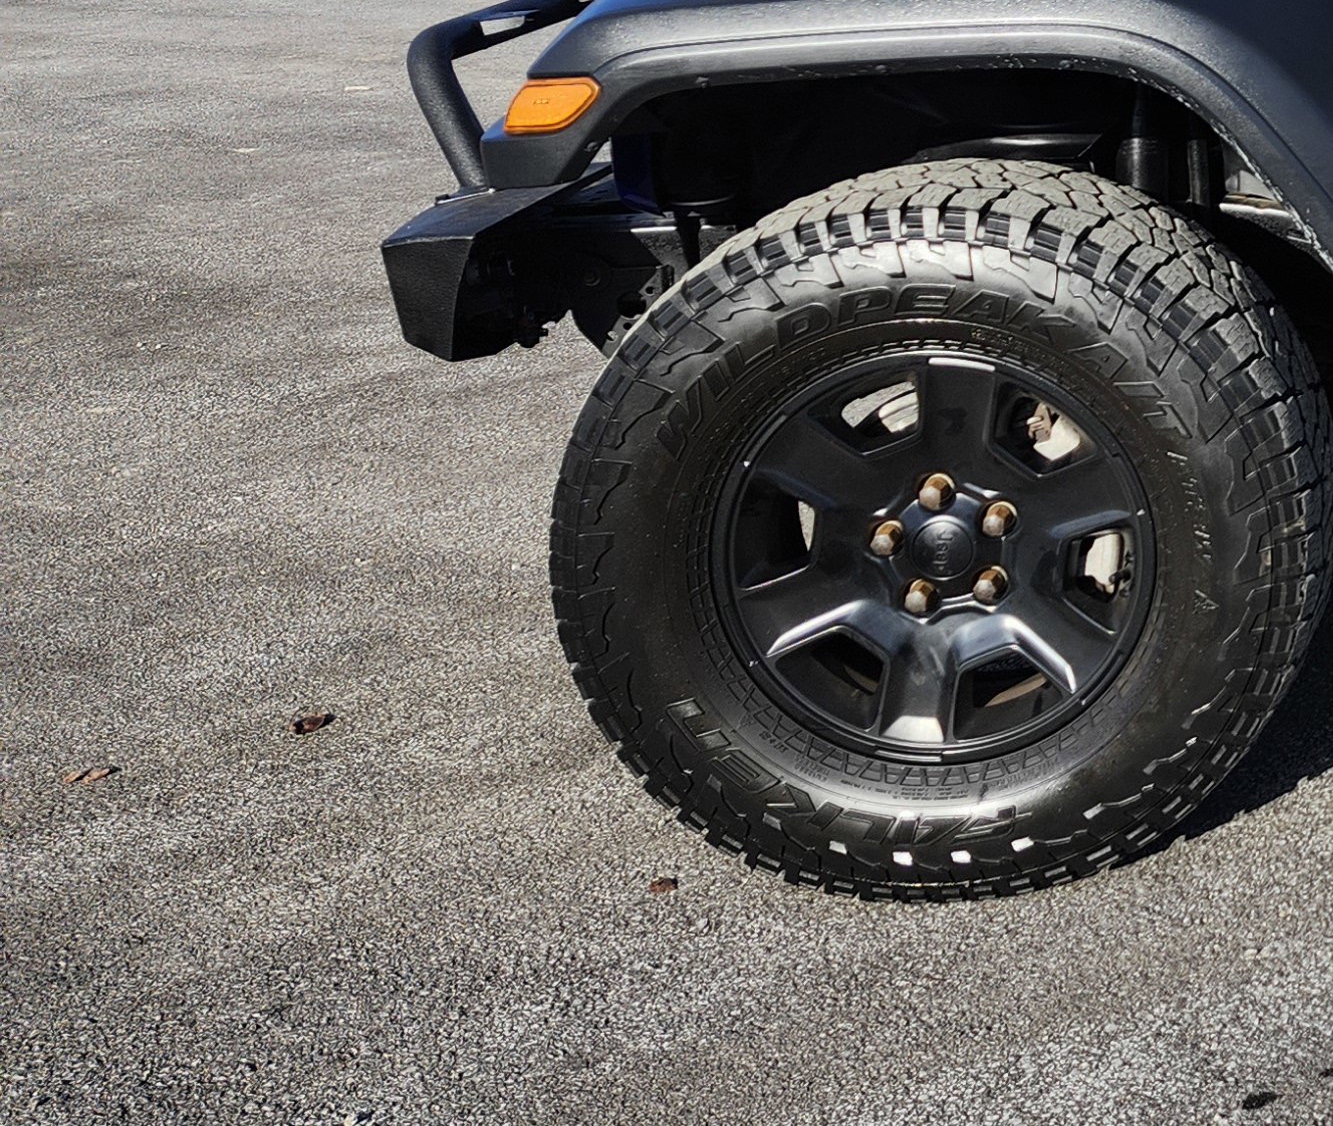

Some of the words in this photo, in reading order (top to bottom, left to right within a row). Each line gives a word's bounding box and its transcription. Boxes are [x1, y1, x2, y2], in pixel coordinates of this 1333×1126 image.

[655, 282, 1075, 462] WILDPEAK
[931, 529, 955, 572] Jeep
[666, 696, 1030, 849] FALKEN
